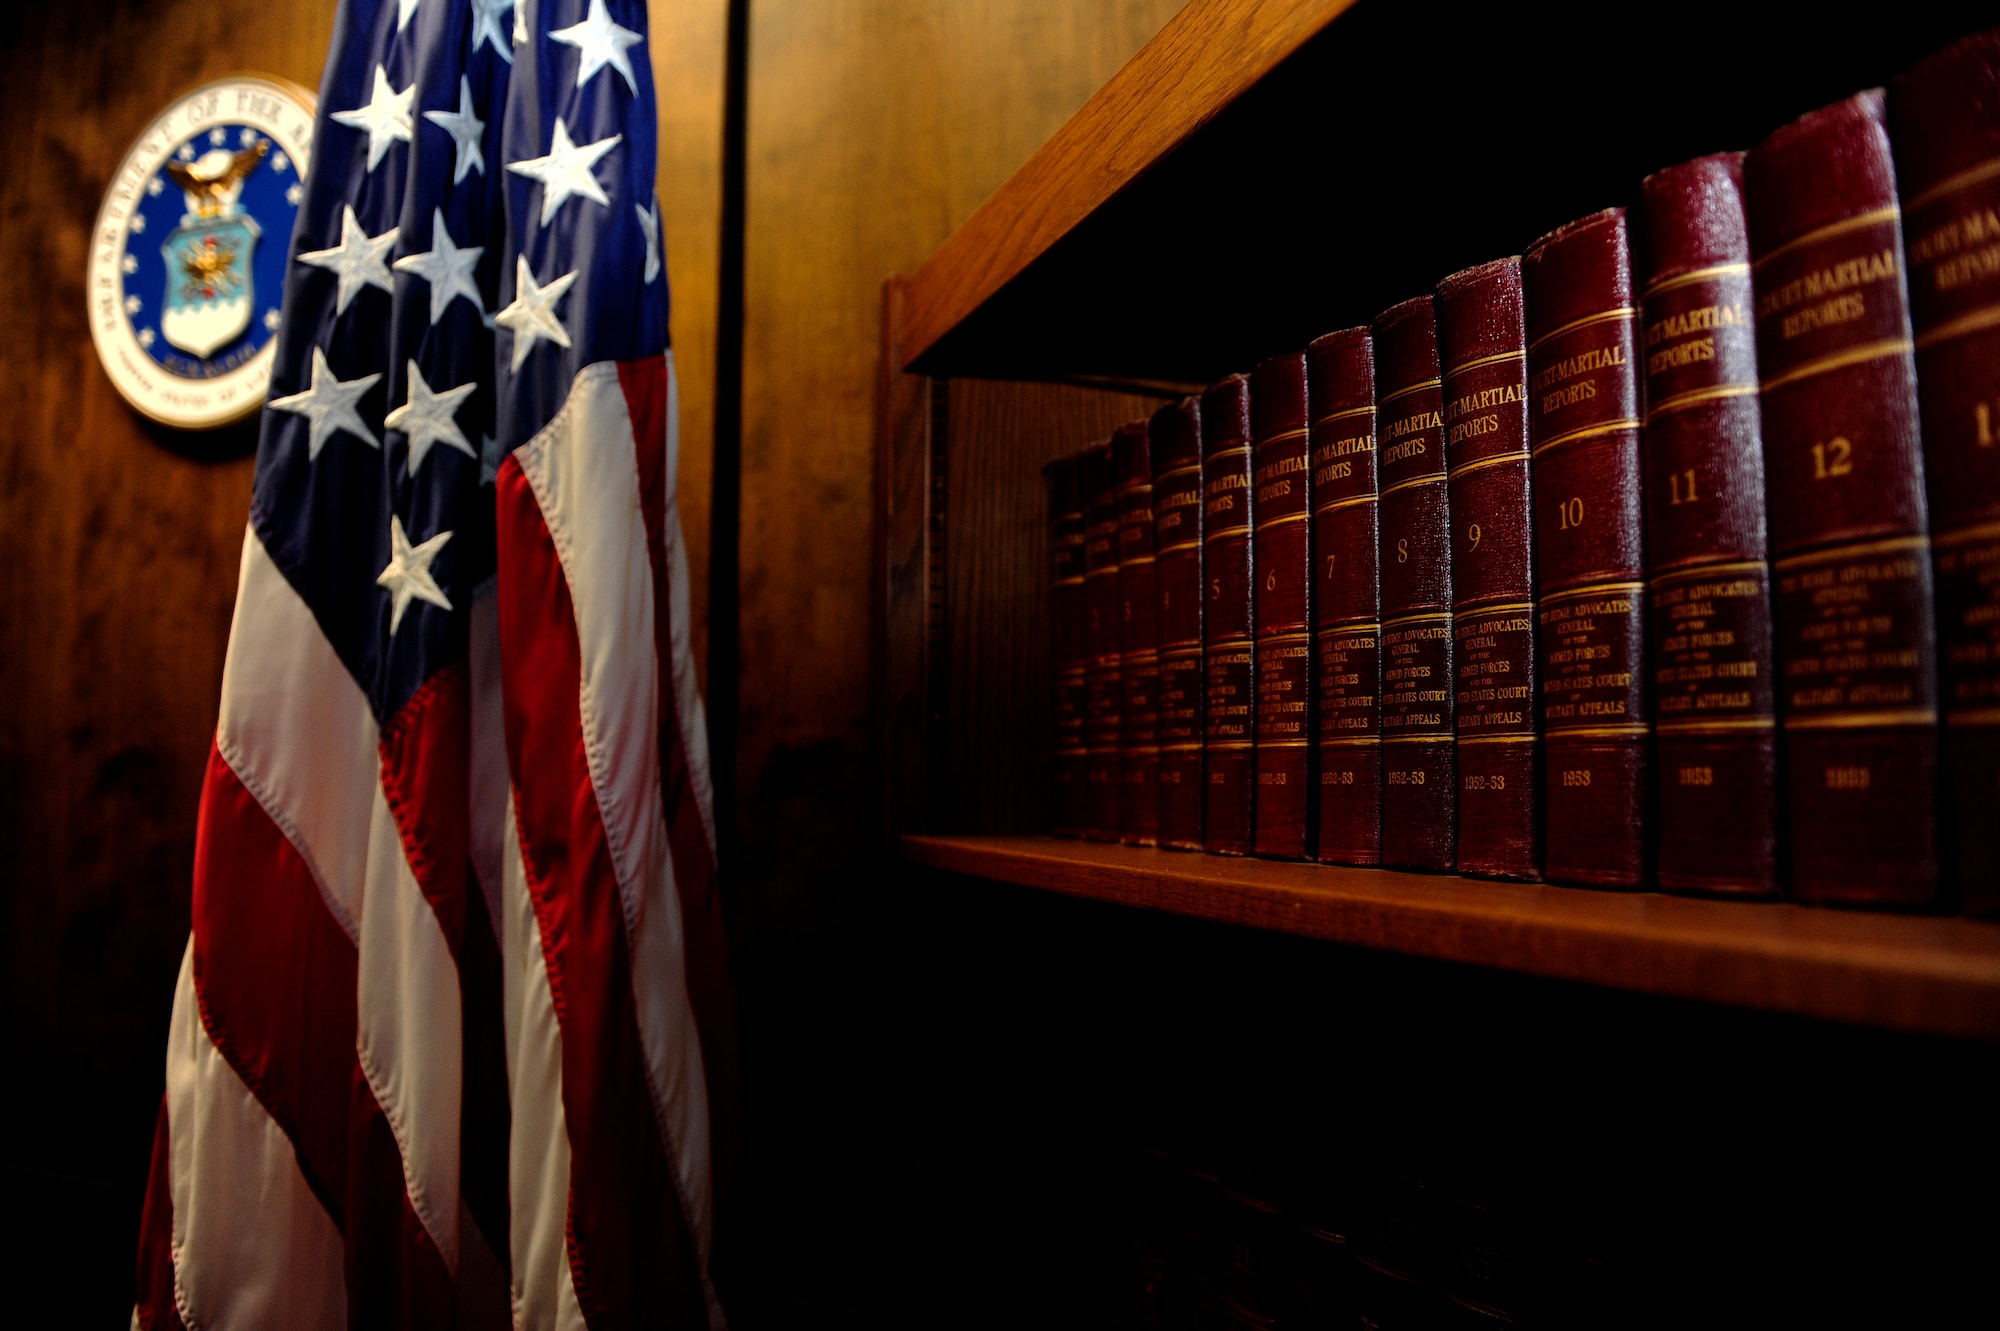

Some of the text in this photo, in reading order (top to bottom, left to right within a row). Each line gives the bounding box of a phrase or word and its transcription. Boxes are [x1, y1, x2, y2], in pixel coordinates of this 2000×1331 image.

[1542, 378, 1597, 414] REPORTS
[1449, 413, 1499, 447] REPORTS
[1810, 435, 1854, 481] 12
[1669, 467, 1699, 505] 11
[1559, 496, 1585, 530] 10
[1468, 523, 1481, 552] 9
[1397, 538, 1408, 563] 8
[1326, 554, 1335, 579] 7
[1267, 567, 1276, 591] 6
[1211, 578, 1220, 600] 5
[1574, 599, 1632, 617] ADVOCATES
[1478, 618, 1529, 635] ADVOCATES
[1557, 618, 1596, 635] GENERAL
[1404, 627, 1449, 642] ADVOCATES
[1391, 643, 1420, 656] GENERAL
[1465, 636, 1497, 651] GENERAL
[1478, 652, 1490, 660] THE
[1575, 645, 1611, 660] FORCES
[1404, 666, 1431, 679] FORCES
[1480, 661, 1510, 674] FORCES
[1334, 673, 1359, 686] FORCES
[1481, 678, 1493, 686] THE
[1563, 676, 1593, 690] STATES
[1596, 672, 1631, 687] COURT
[1418, 690, 1448, 702] COURT
[1471, 688, 1495, 702] STATES
[1497, 686, 1529, 699] COURT
[1282, 701, 1305, 713] COURT
[1348, 696, 1374, 708] COURT
[1578, 700, 1626, 715] APPEALS
[1337, 717, 1369, 730] APPEALS
[1405, 713, 1441, 725] APPEALS
[1483, 712, 1522, 725] APPEALS
[1388, 771, 1425, 785] 1952-53
[1464, 775, 1506, 790] 1952-53
[1562, 769, 1592, 787] 1953
